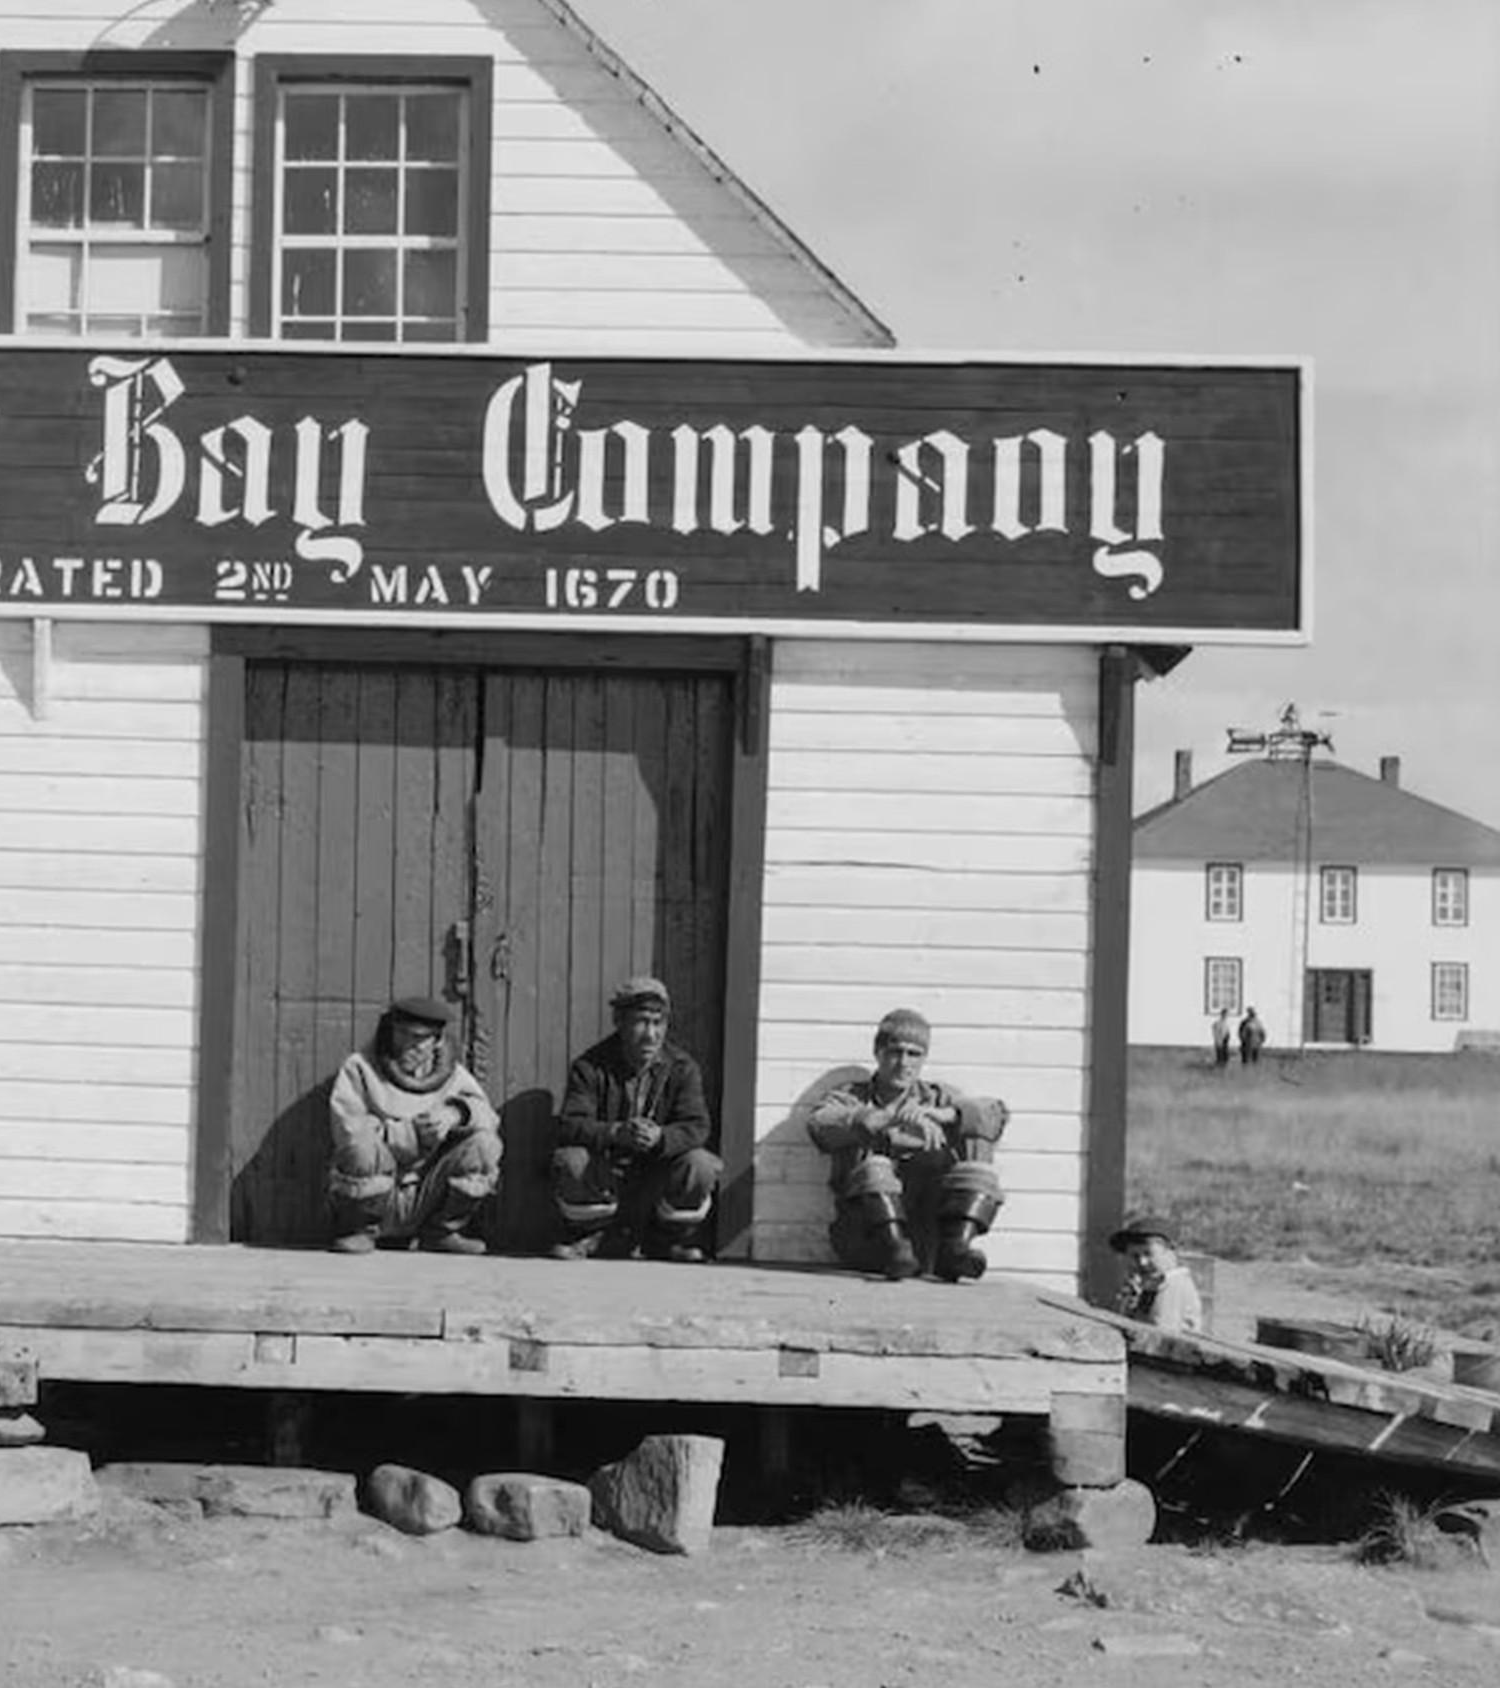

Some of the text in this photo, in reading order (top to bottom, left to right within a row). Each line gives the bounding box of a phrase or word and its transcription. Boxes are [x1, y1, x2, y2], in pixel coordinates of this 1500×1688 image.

[86, 355, 371, 586] Bay
[482, 362, 1166, 602] Company
[370, 565, 494, 605] MAY
[545, 568, 680, 610] 1670
